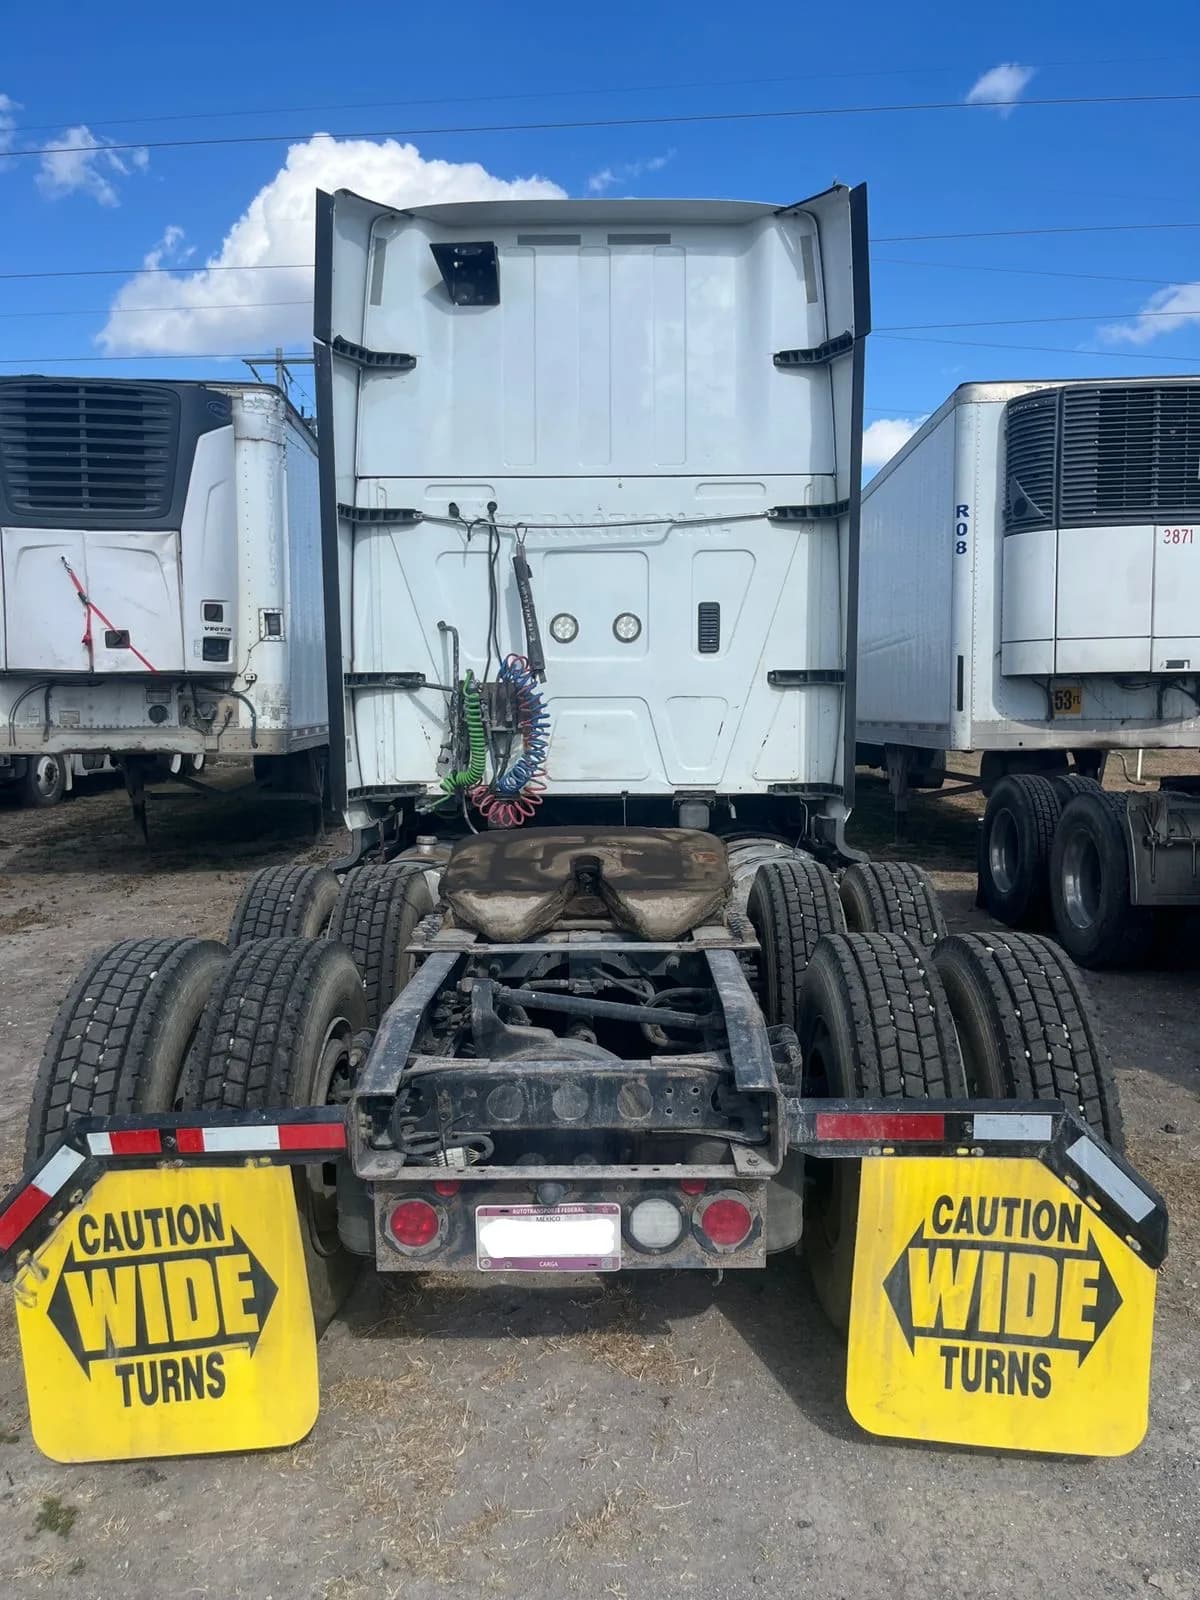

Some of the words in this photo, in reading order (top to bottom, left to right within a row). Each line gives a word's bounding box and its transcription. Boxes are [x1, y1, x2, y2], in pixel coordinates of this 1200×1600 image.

[956, 504, 970, 555] R08
[1163, 529, 1193, 544] 3871
[1055, 689, 1072, 710] 53
[78, 1202, 225, 1255] CAUTION
[932, 1195, 1082, 1244] CAUTION
[539, 1260, 559, 1268] CARGA
[63, 1253, 259, 1352] WIDE
[908, 1247, 1100, 1342] WIDE
[115, 1351, 226, 1407] TURNS
[940, 1345, 1051, 1399] TURNS
